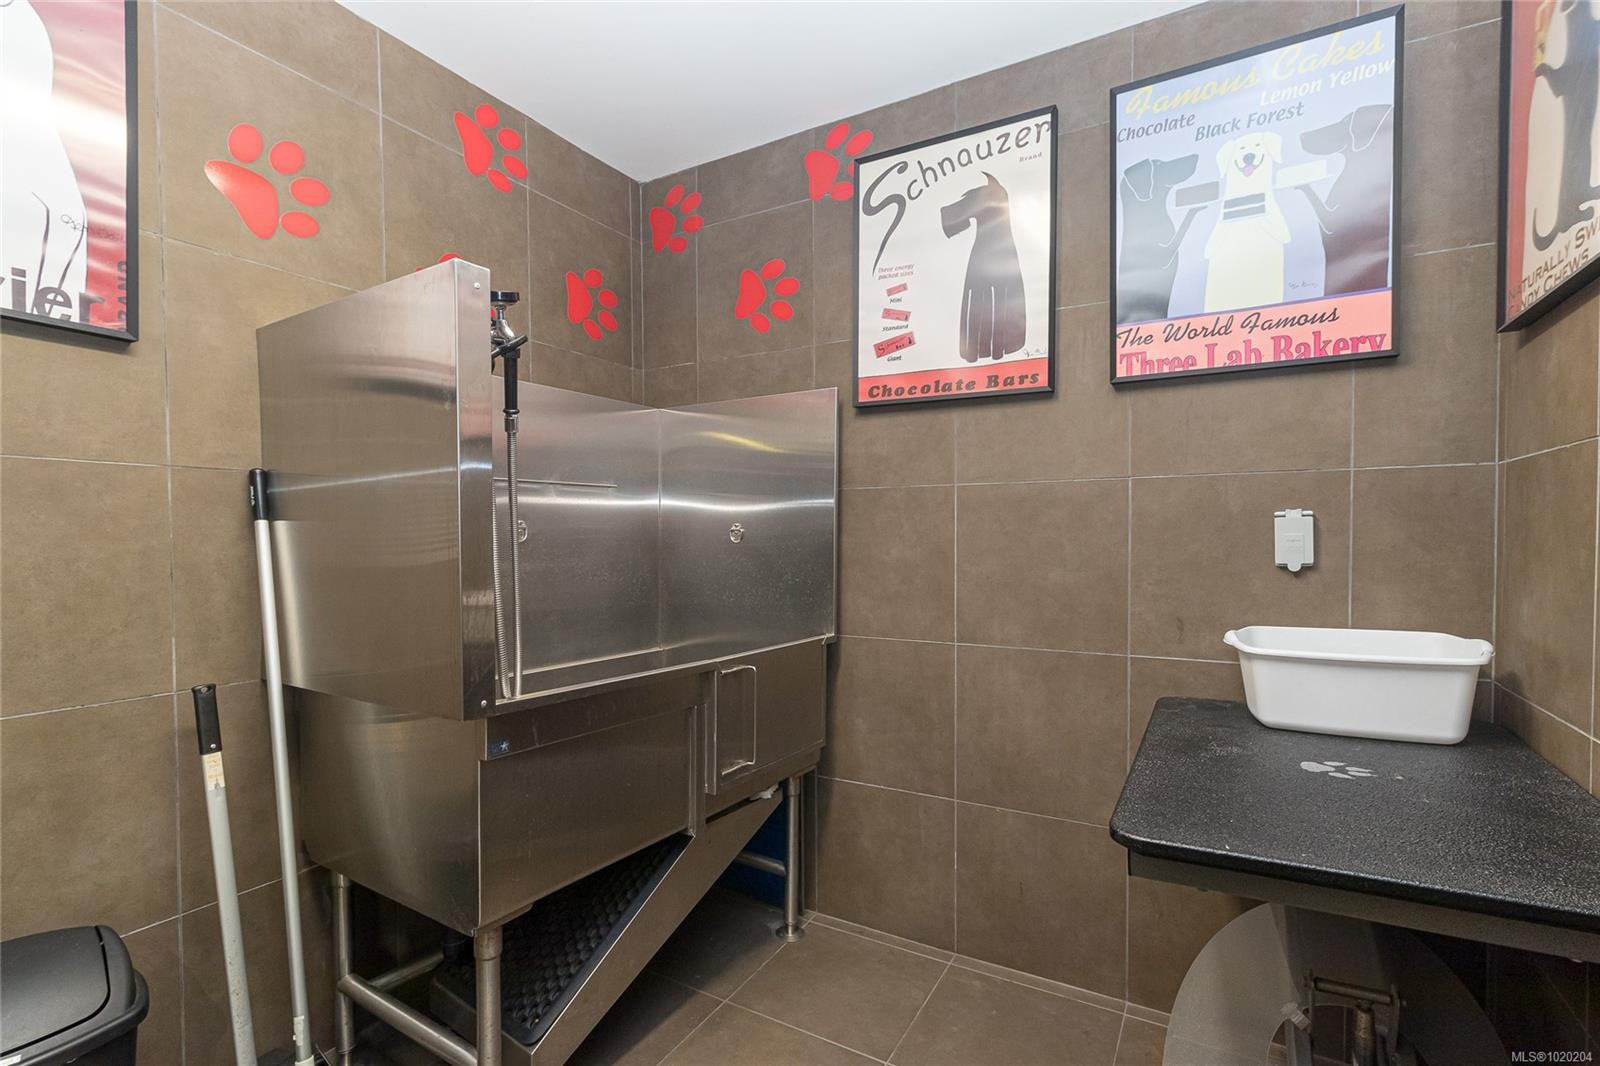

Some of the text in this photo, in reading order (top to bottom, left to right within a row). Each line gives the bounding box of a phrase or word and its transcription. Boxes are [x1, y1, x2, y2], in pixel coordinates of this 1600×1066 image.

[1125, 31, 1385, 120] Famous Cakes
[1260, 58, 1394, 106] Lemon Yellow
[1117, 101, 1305, 143] Chocolate Black Forest
[862, 120, 1050, 276] Schnauzer
[1543, 248, 1589, 292] CHEWS
[882, 324, 909, 332] Standard
[1117, 307, 1340, 349] The World Famous
[1120, 331, 1387, 376] Three Lab Bakery
[868, 372, 1040, 399] Chocolate Bars
